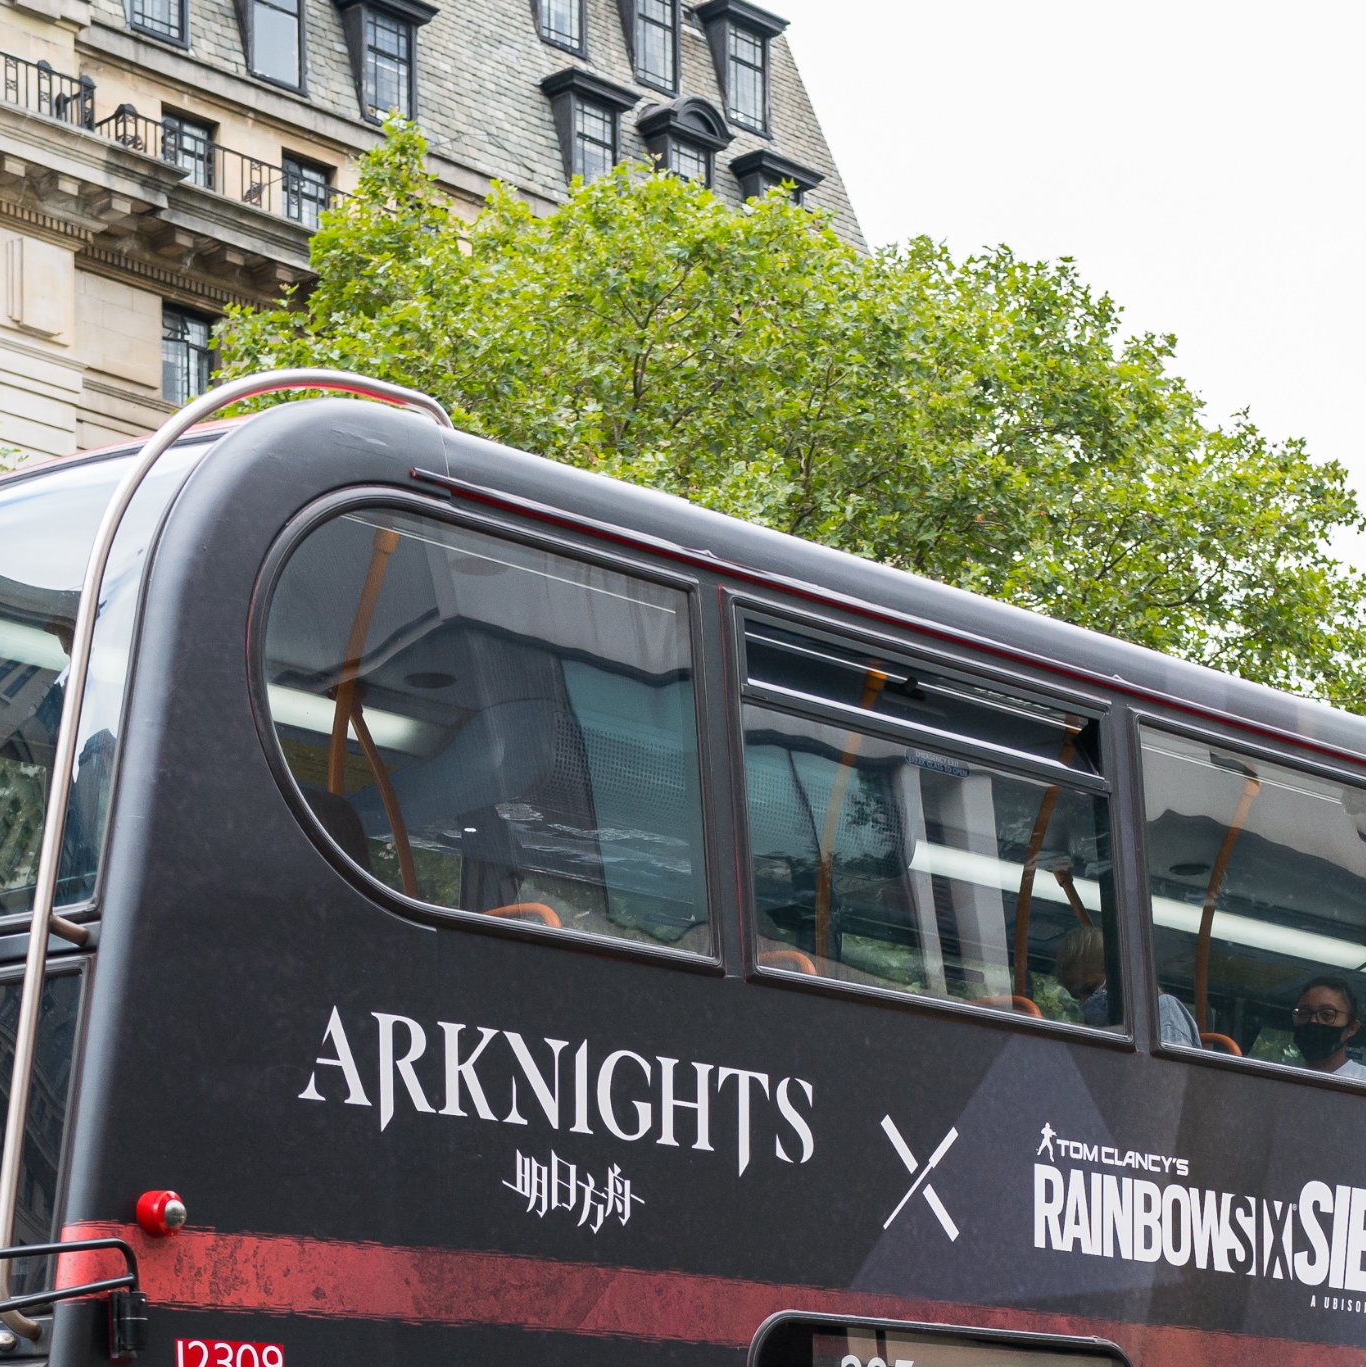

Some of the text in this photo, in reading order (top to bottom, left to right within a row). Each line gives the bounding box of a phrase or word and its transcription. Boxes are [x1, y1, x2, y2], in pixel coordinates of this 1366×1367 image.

[298, 1004, 815, 1177] ARKNIGHTS
[1056, 1138, 1190, 1177] TOM CLANCY'S
[503, 1148, 645, 1234] 明日方舟
[1310, 1294, 1316, 1308] A
